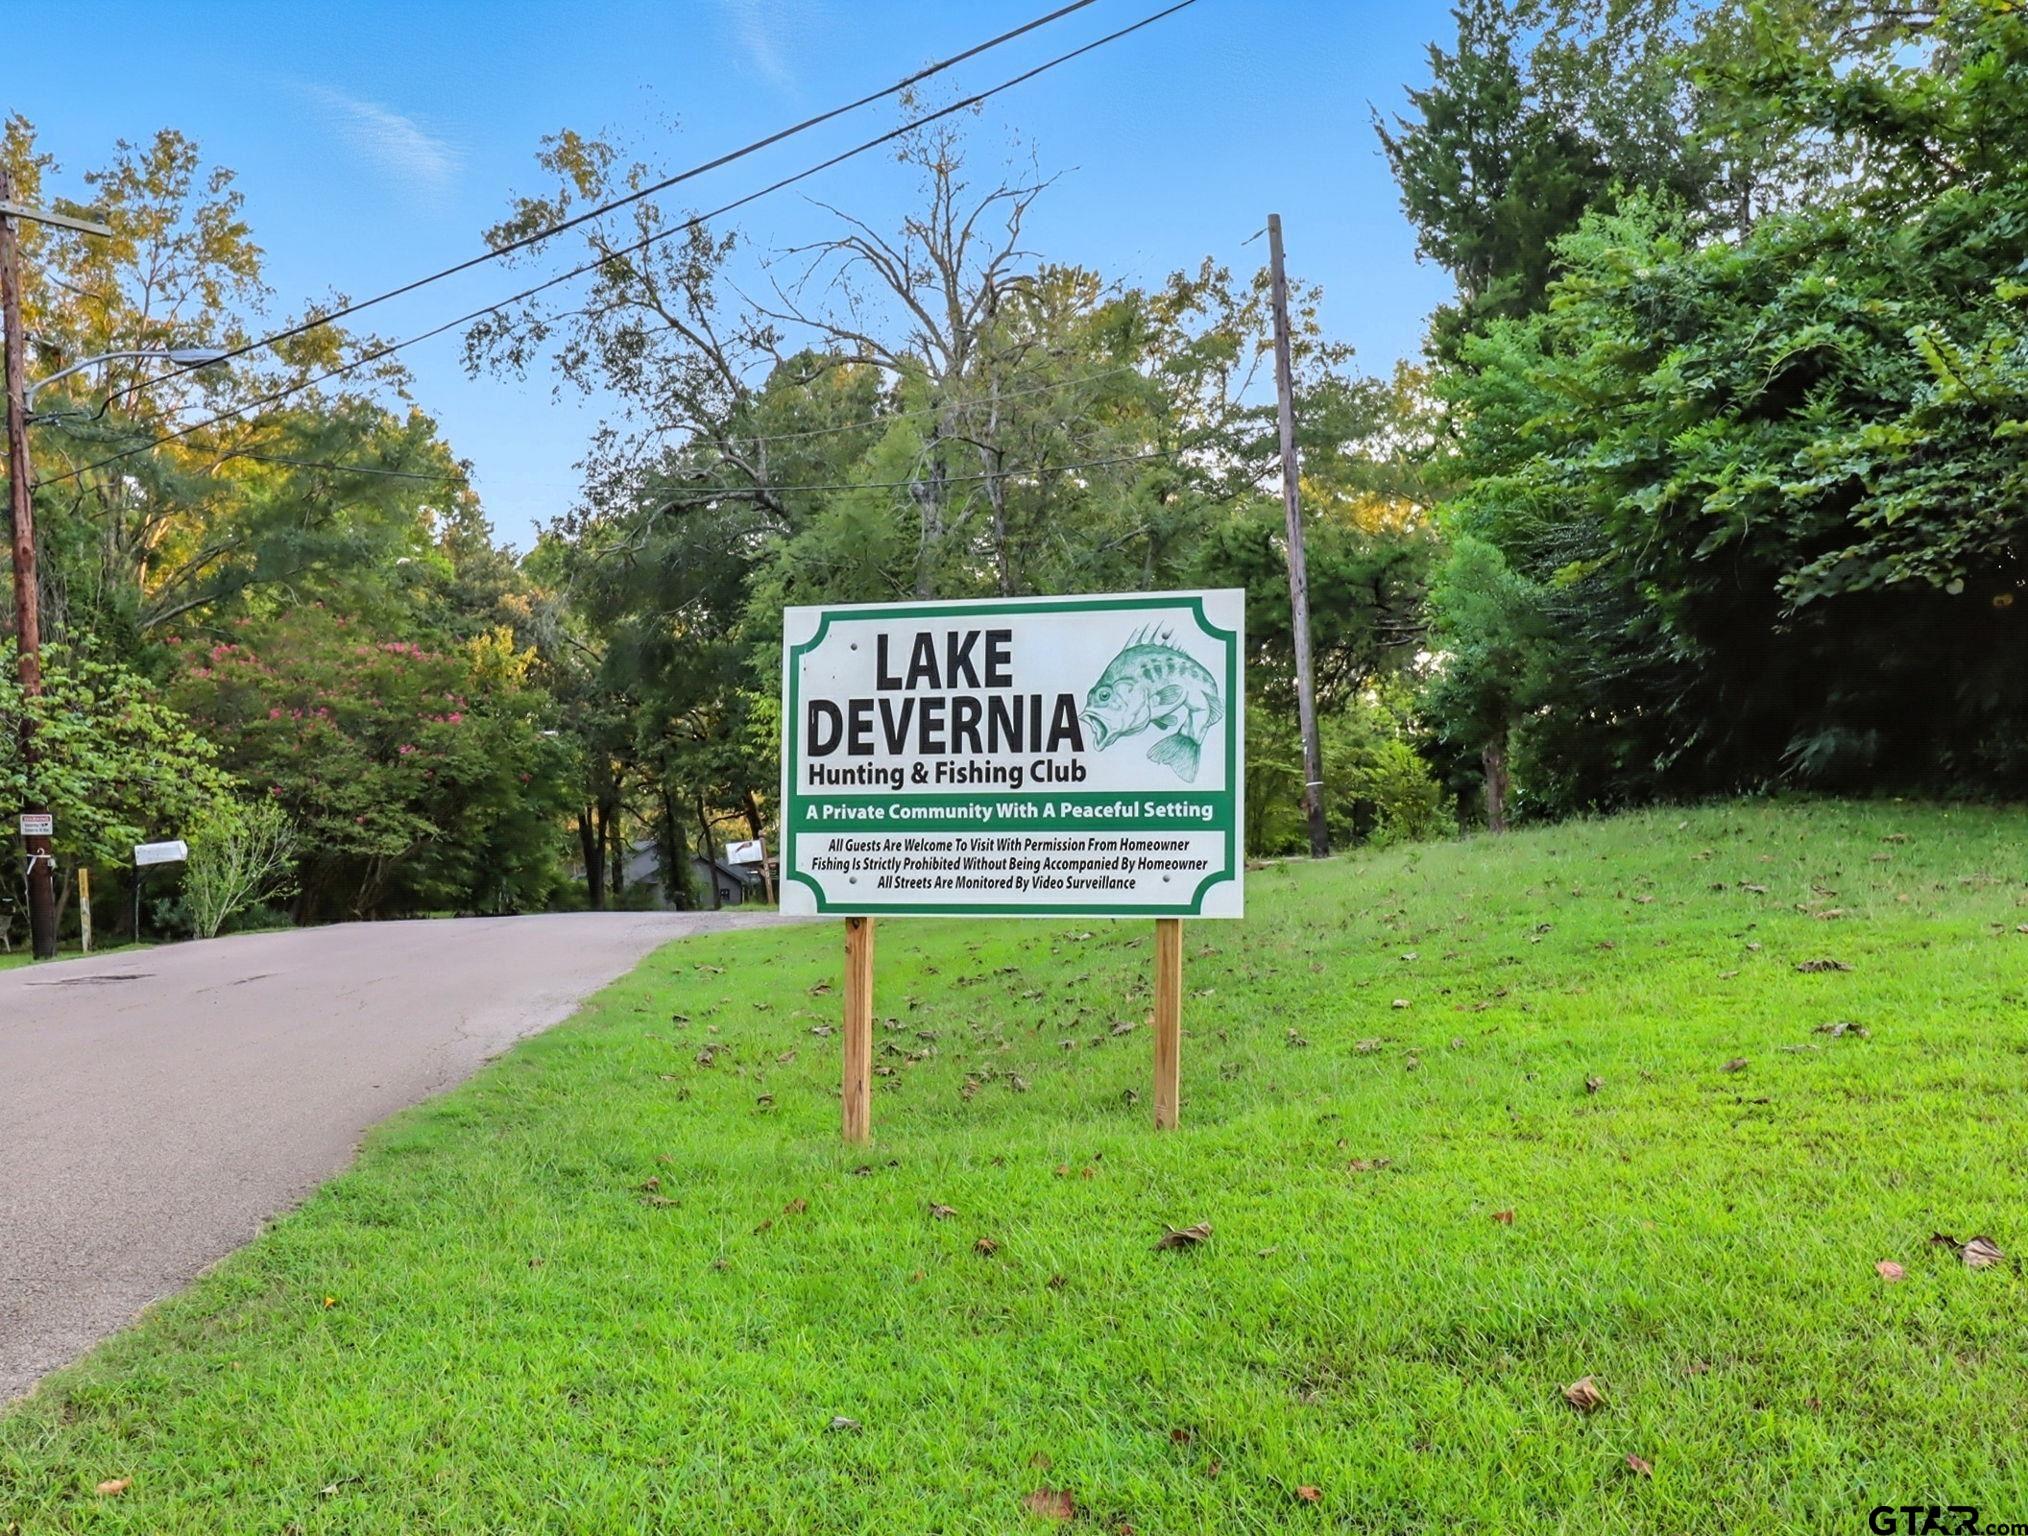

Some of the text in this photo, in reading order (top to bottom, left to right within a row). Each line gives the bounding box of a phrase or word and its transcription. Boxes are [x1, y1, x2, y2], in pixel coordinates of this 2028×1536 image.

[876, 629, 1012, 691] LAKE
[807, 693, 1085, 757] DEVERNIA
[808, 758, 1087, 791] Hunting & Fishing Club
[806, 801, 1214, 822] A Private Community With A Peaceful Setting
[828, 837, 1190, 852] All Guests Are Welcome To Visit With Permission From Homeowner
[811, 856, 1208, 874] Fishing Is Strictly Prohibited Without Being Accompanied By Homeowner
[877, 876, 1136, 892] All Streets Are Monitored By Video Surveillance
